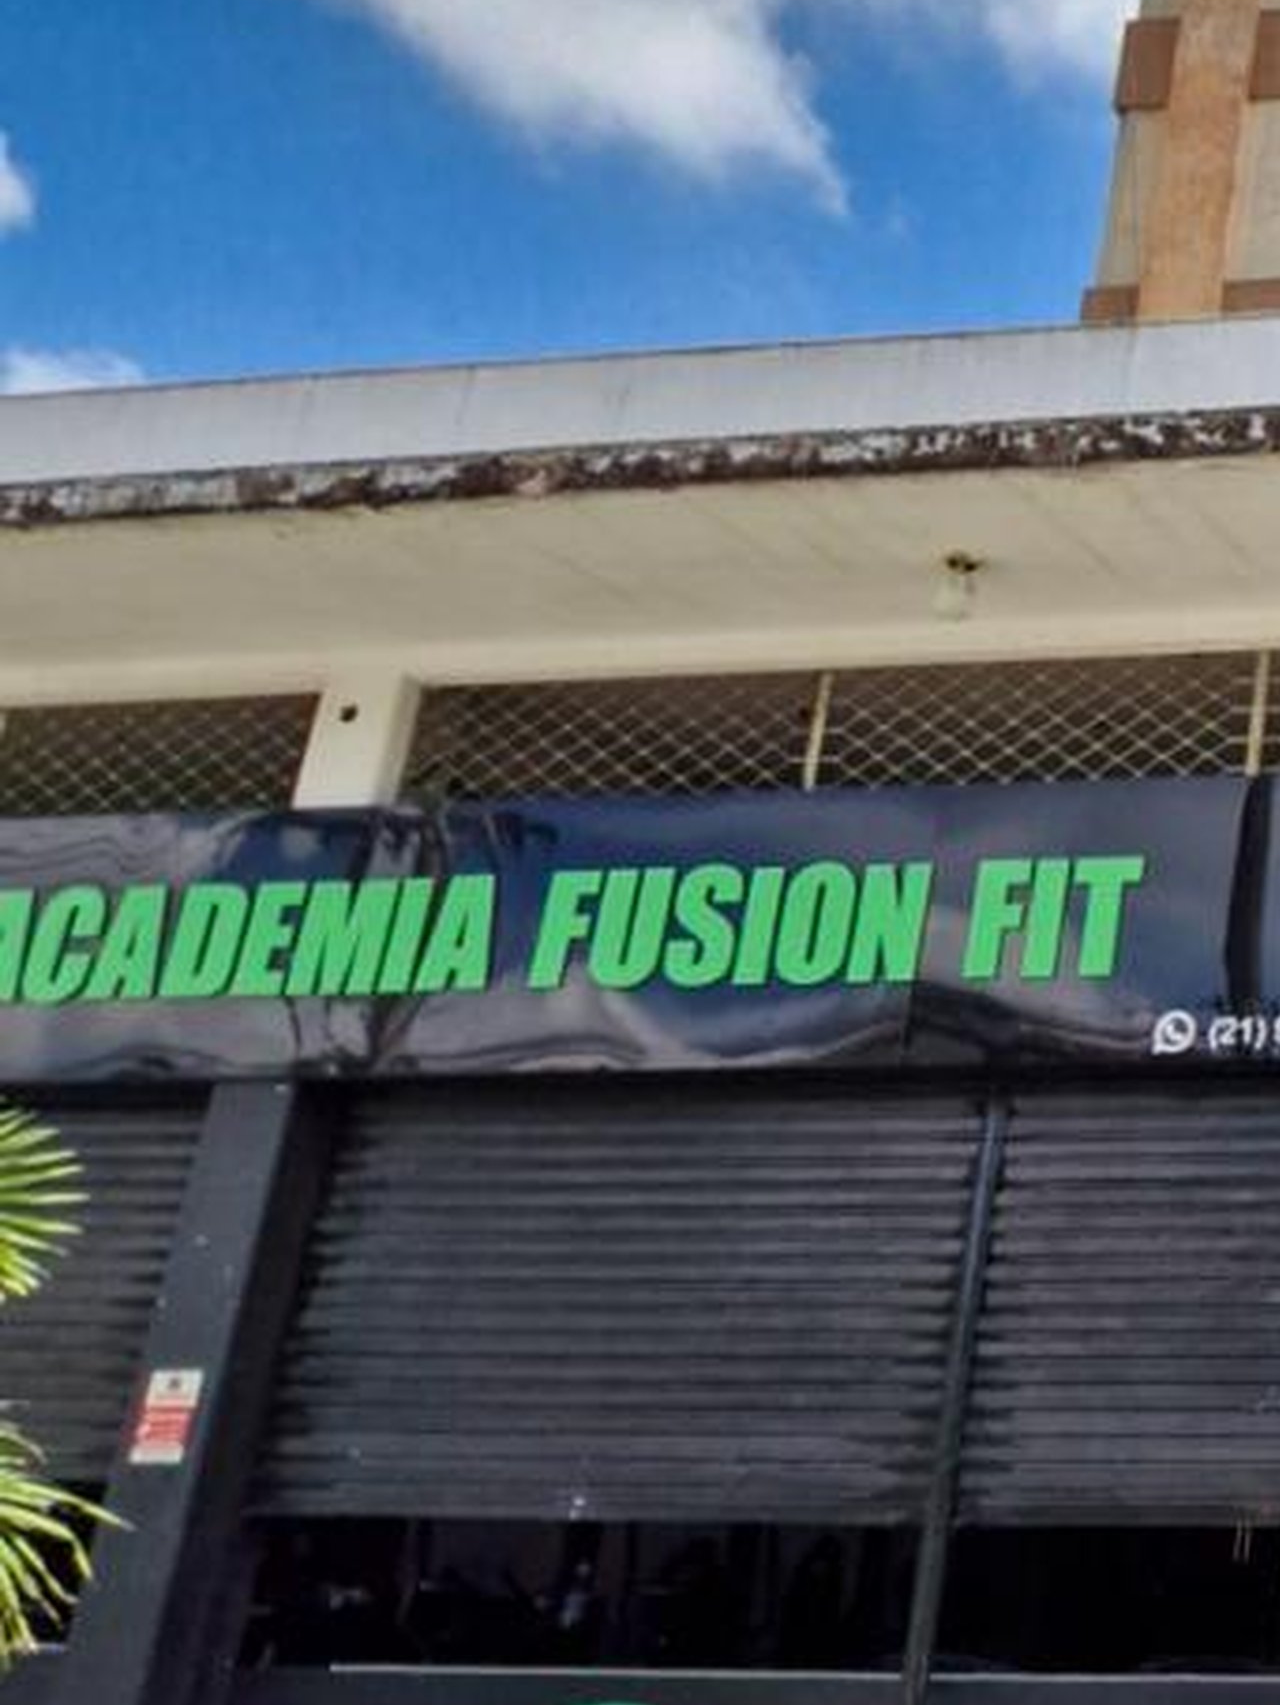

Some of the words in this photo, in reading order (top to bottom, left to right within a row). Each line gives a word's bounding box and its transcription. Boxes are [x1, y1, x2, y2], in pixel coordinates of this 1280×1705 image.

[527, 860, 933, 990] FUSION
[960, 855, 1144, 983] FIT
[1208, 1015, 1267, 1051] (21)
